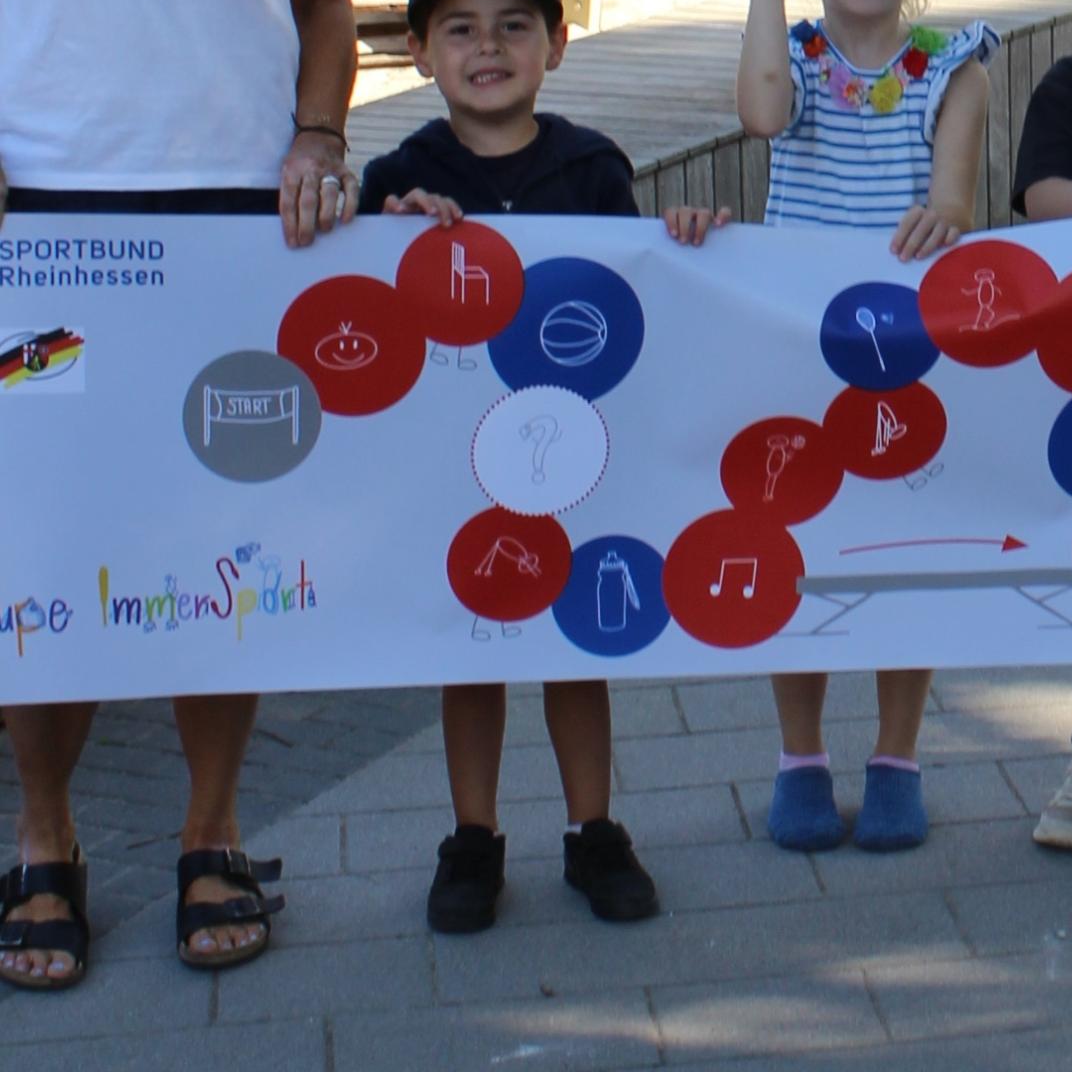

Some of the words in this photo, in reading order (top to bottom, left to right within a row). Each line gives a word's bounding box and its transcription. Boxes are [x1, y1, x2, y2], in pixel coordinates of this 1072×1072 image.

[0, 239, 164, 260] SPORTBUND
[0, 265, 164, 286] Rheinhessen
[226, 397, 272, 416] START
